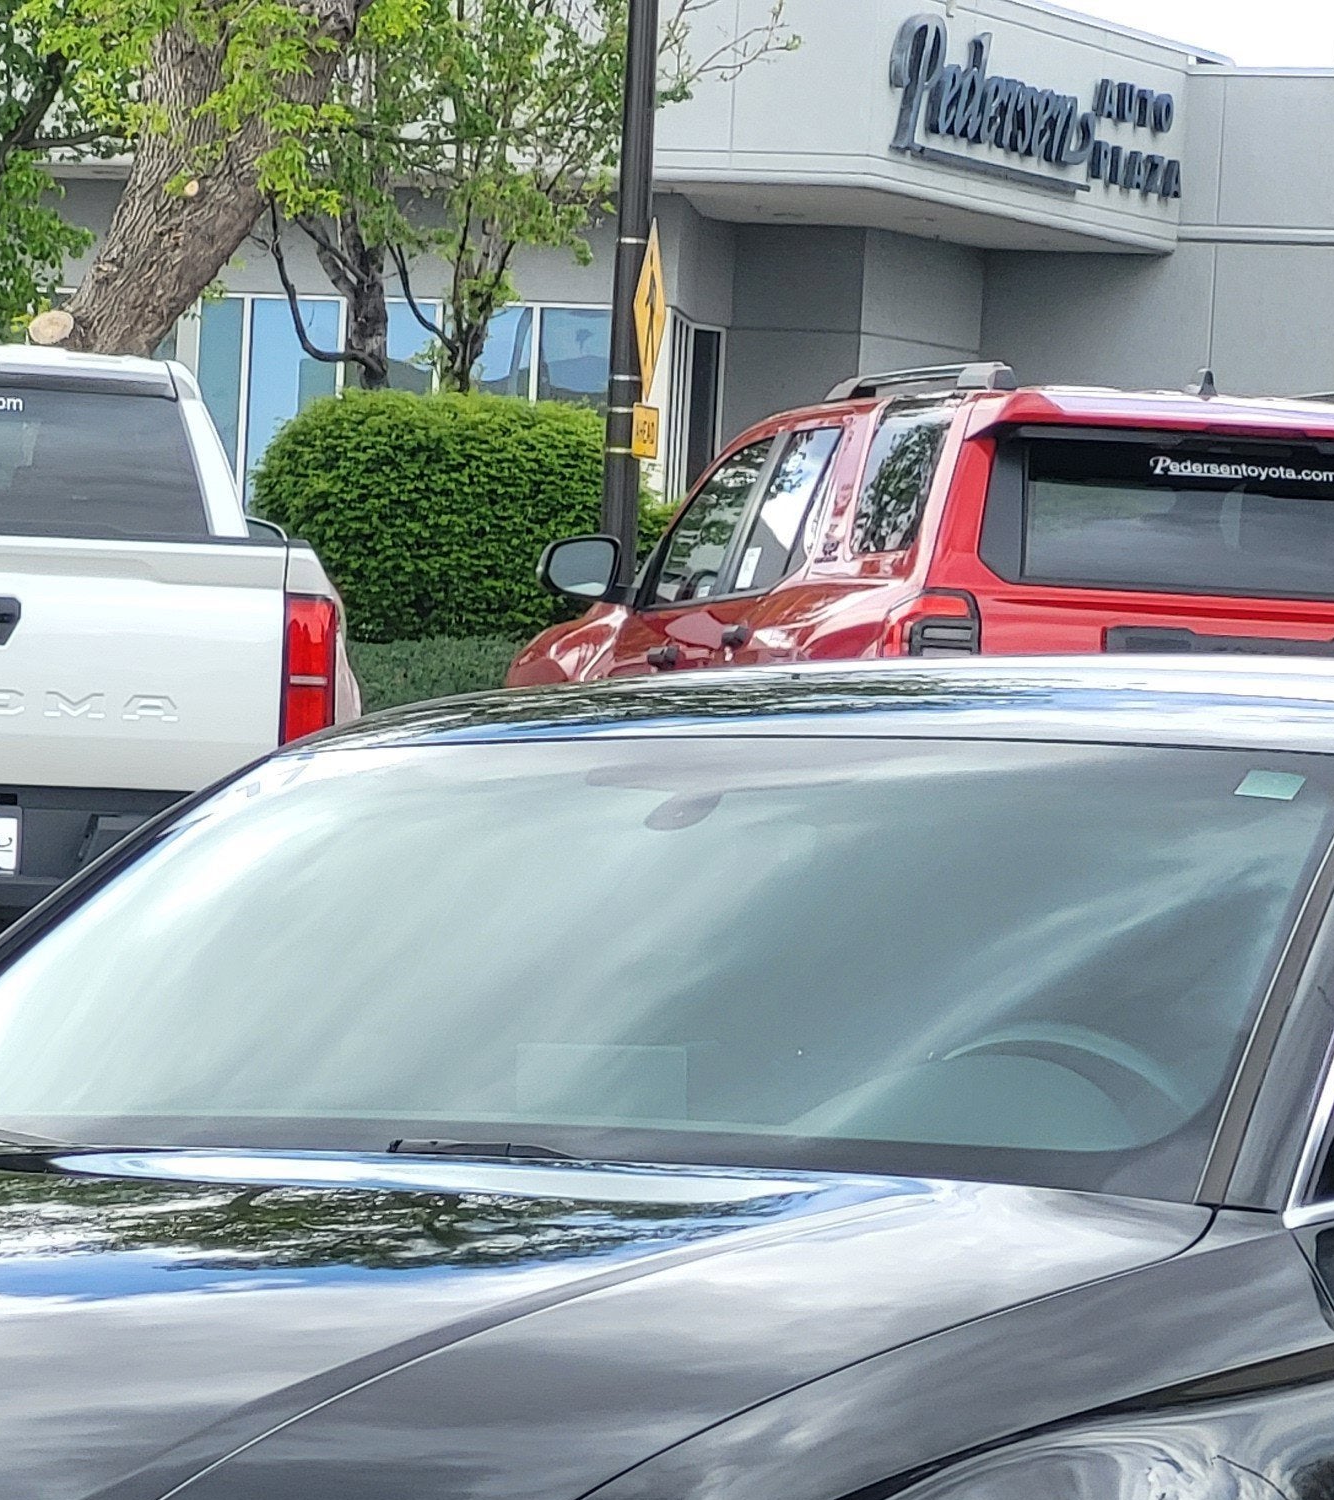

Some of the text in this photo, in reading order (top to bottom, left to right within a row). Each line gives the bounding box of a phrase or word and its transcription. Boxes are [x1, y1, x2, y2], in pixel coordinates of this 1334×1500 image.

[889, 14, 1096, 165] Pedersen
[1092, 79, 1174, 133] AUTO
[1087, 140, 1181, 198] PLAZA
